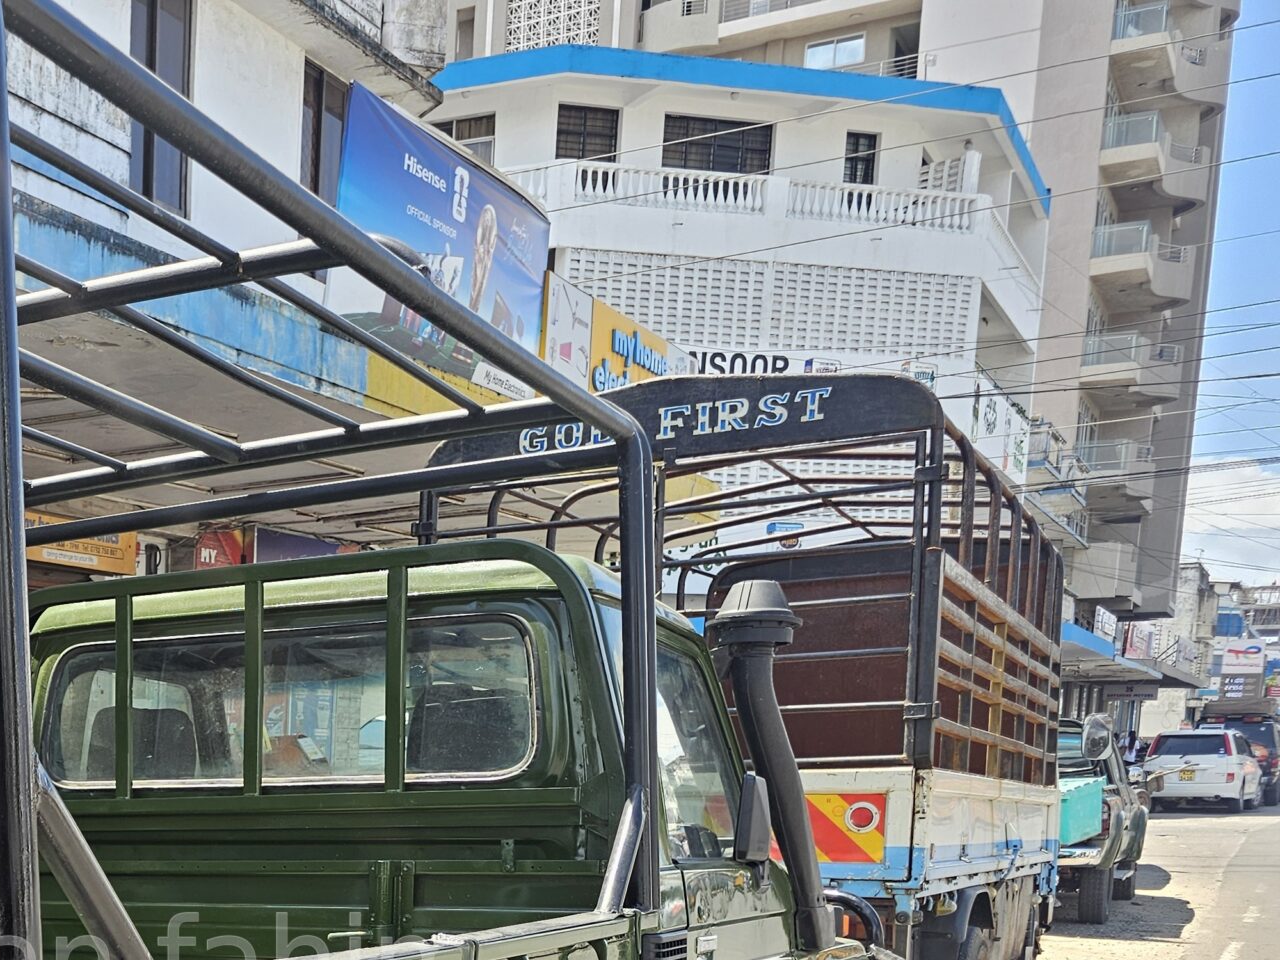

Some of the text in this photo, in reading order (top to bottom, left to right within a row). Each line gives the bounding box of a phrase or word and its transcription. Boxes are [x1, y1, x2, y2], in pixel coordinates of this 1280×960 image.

[404, 152, 447, 193] Hisense
[406, 204, 457, 240] OFFICIAL SPONSOR
[655, 386, 833, 440] FIRST
[200, 547, 218, 563] MY
